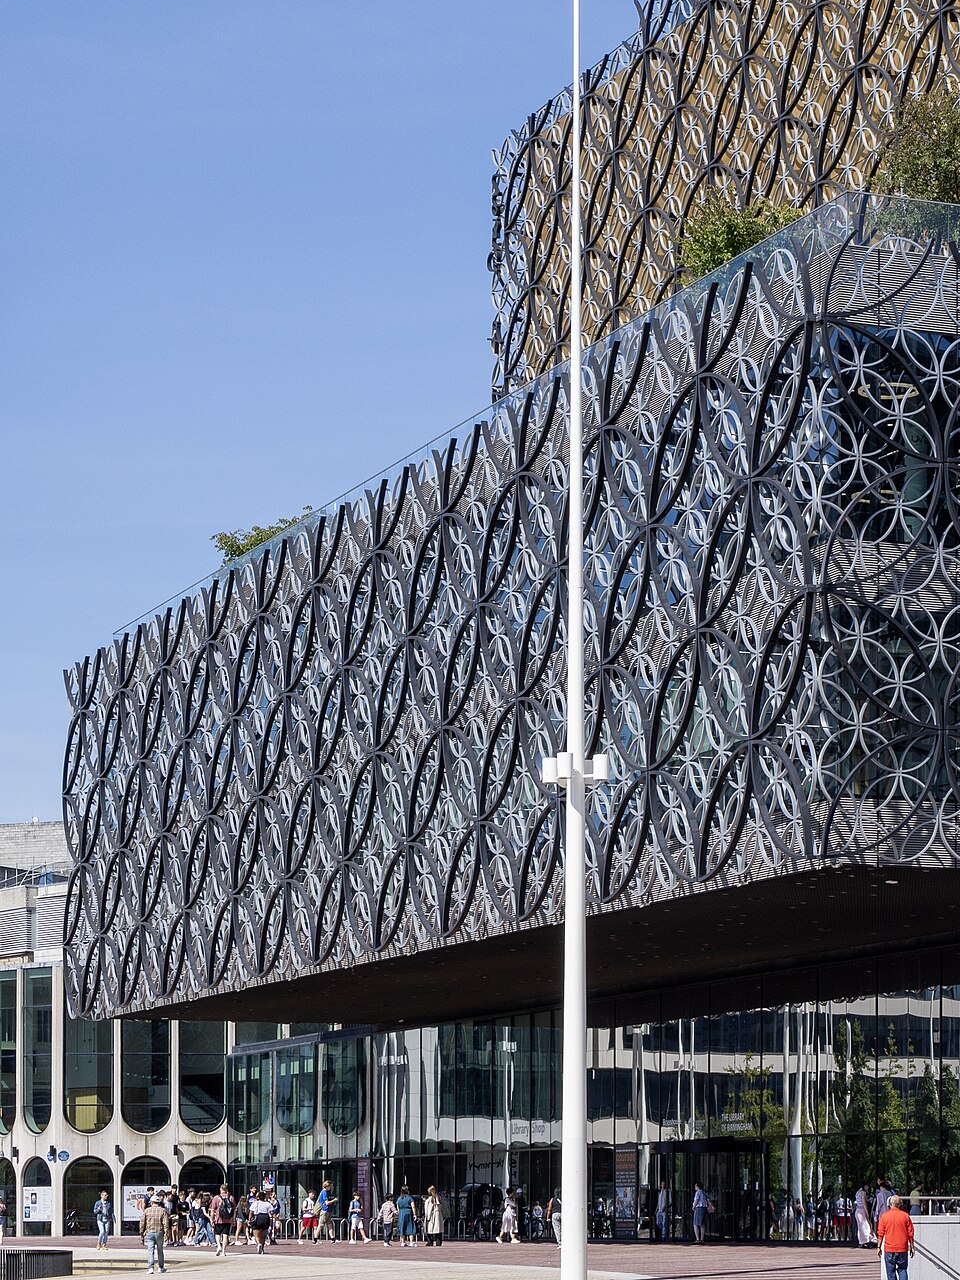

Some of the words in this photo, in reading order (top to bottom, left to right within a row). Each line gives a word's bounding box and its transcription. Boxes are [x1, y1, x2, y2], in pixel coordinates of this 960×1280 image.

[721, 1113, 729, 1122] THE
[729, 1112, 744, 1121] LIBRARY
[511, 1123, 529, 1137] Library
[531, 1122, 546, 1136] Shop
[721, 1123, 727, 1132] OF
[727, 1122, 753, 1132] BIRMINGHAM
